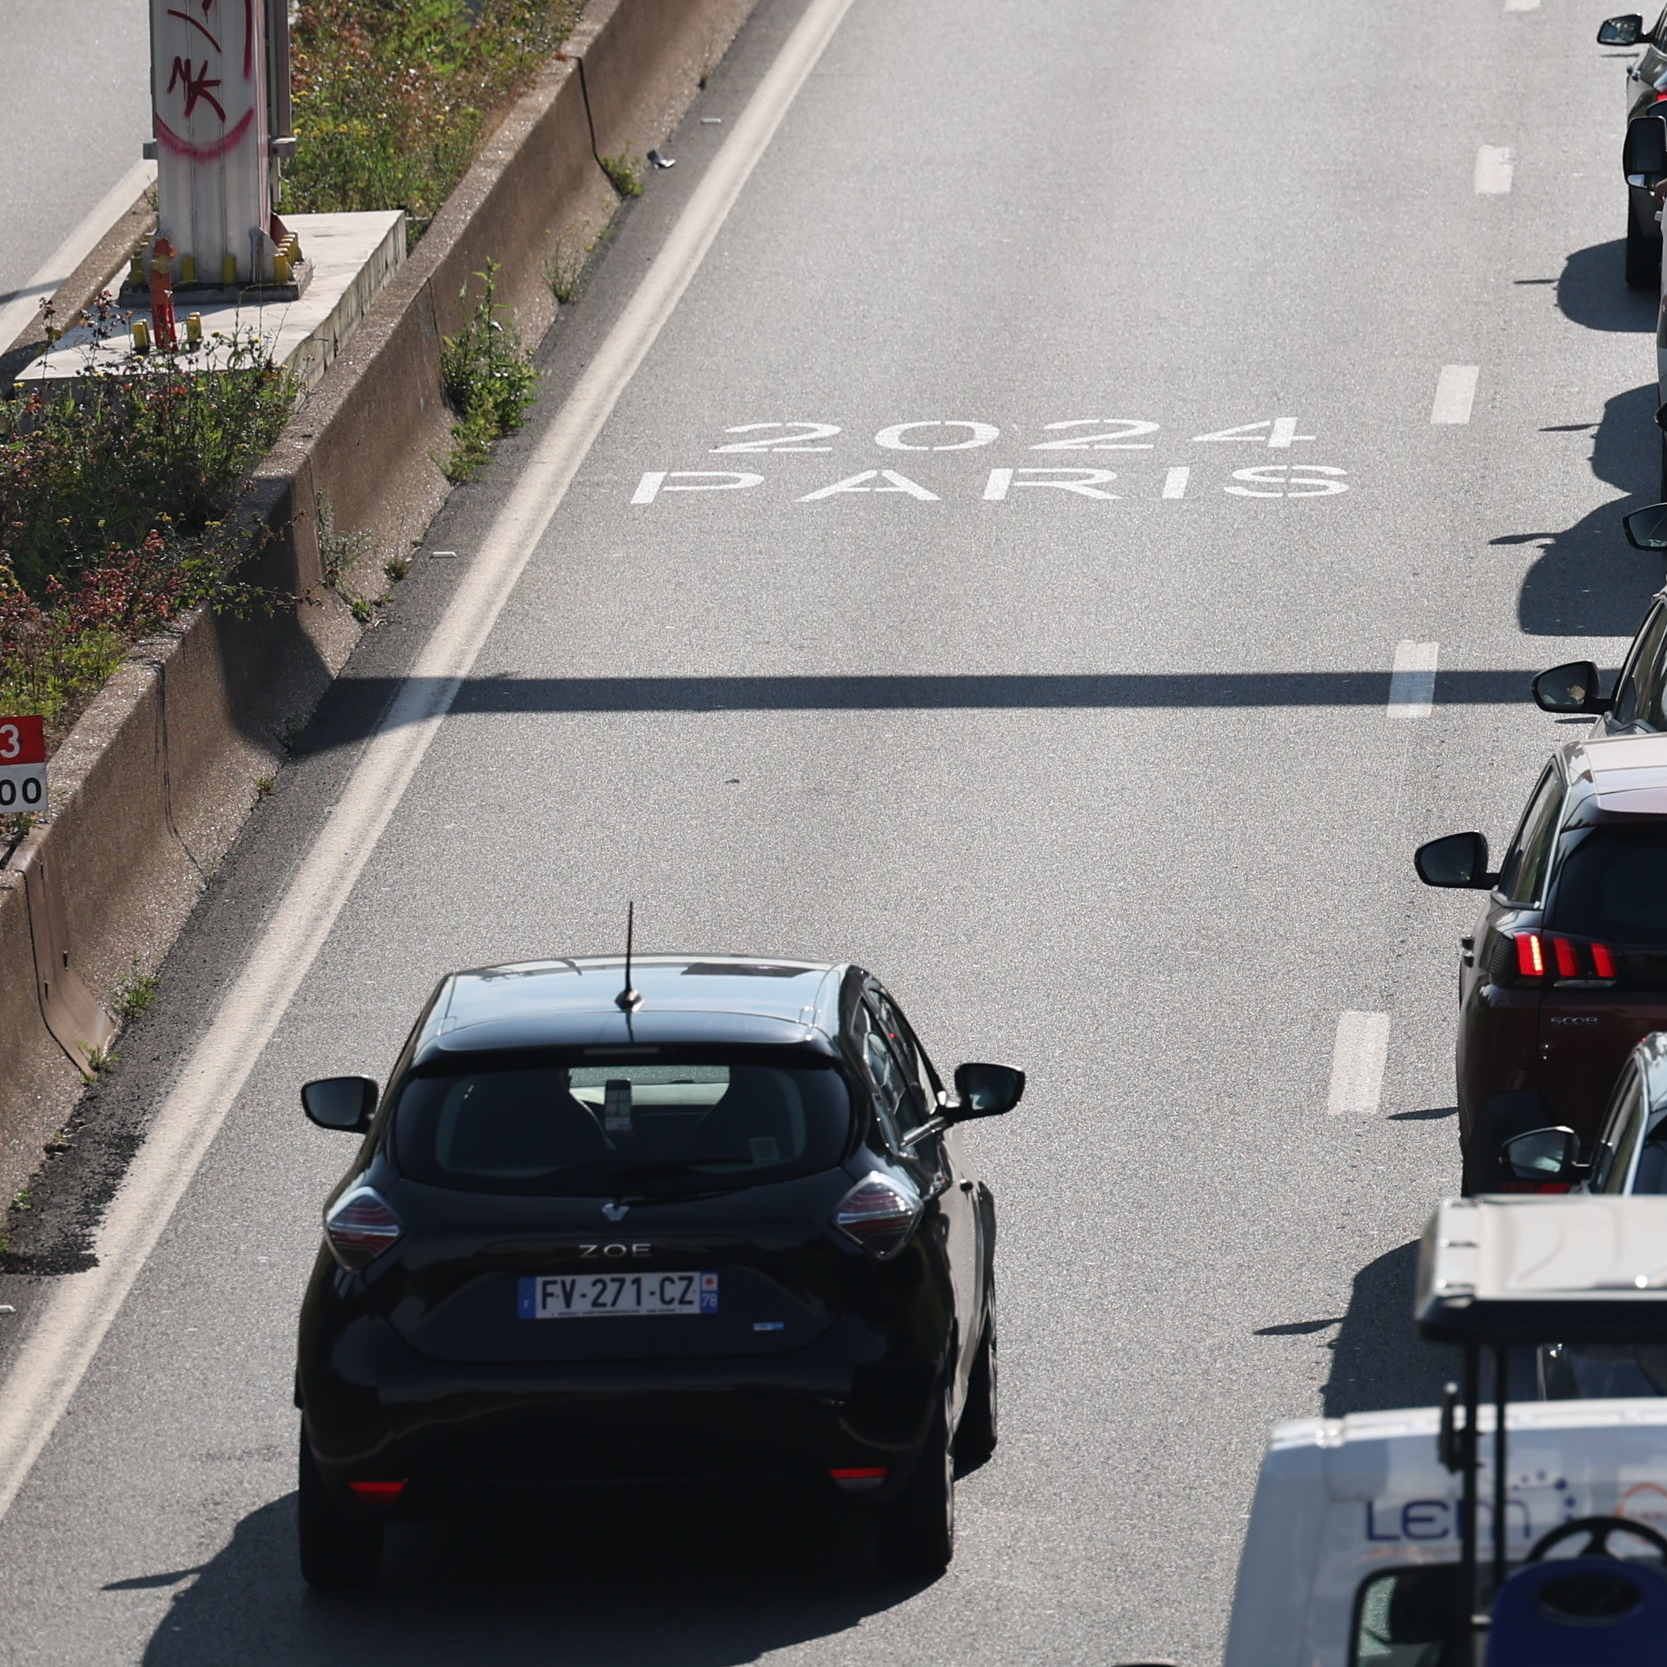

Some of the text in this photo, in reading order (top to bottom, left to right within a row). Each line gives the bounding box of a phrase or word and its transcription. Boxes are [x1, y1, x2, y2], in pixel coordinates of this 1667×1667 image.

[709, 417, 1317, 453] 2024
[630, 464, 1350, 504] PARIS
[578, 1243, 653, 1259] ZOE
[541, 1275, 696, 1310] FV-271-CZ
[702, 1293, 718, 1308] 78
